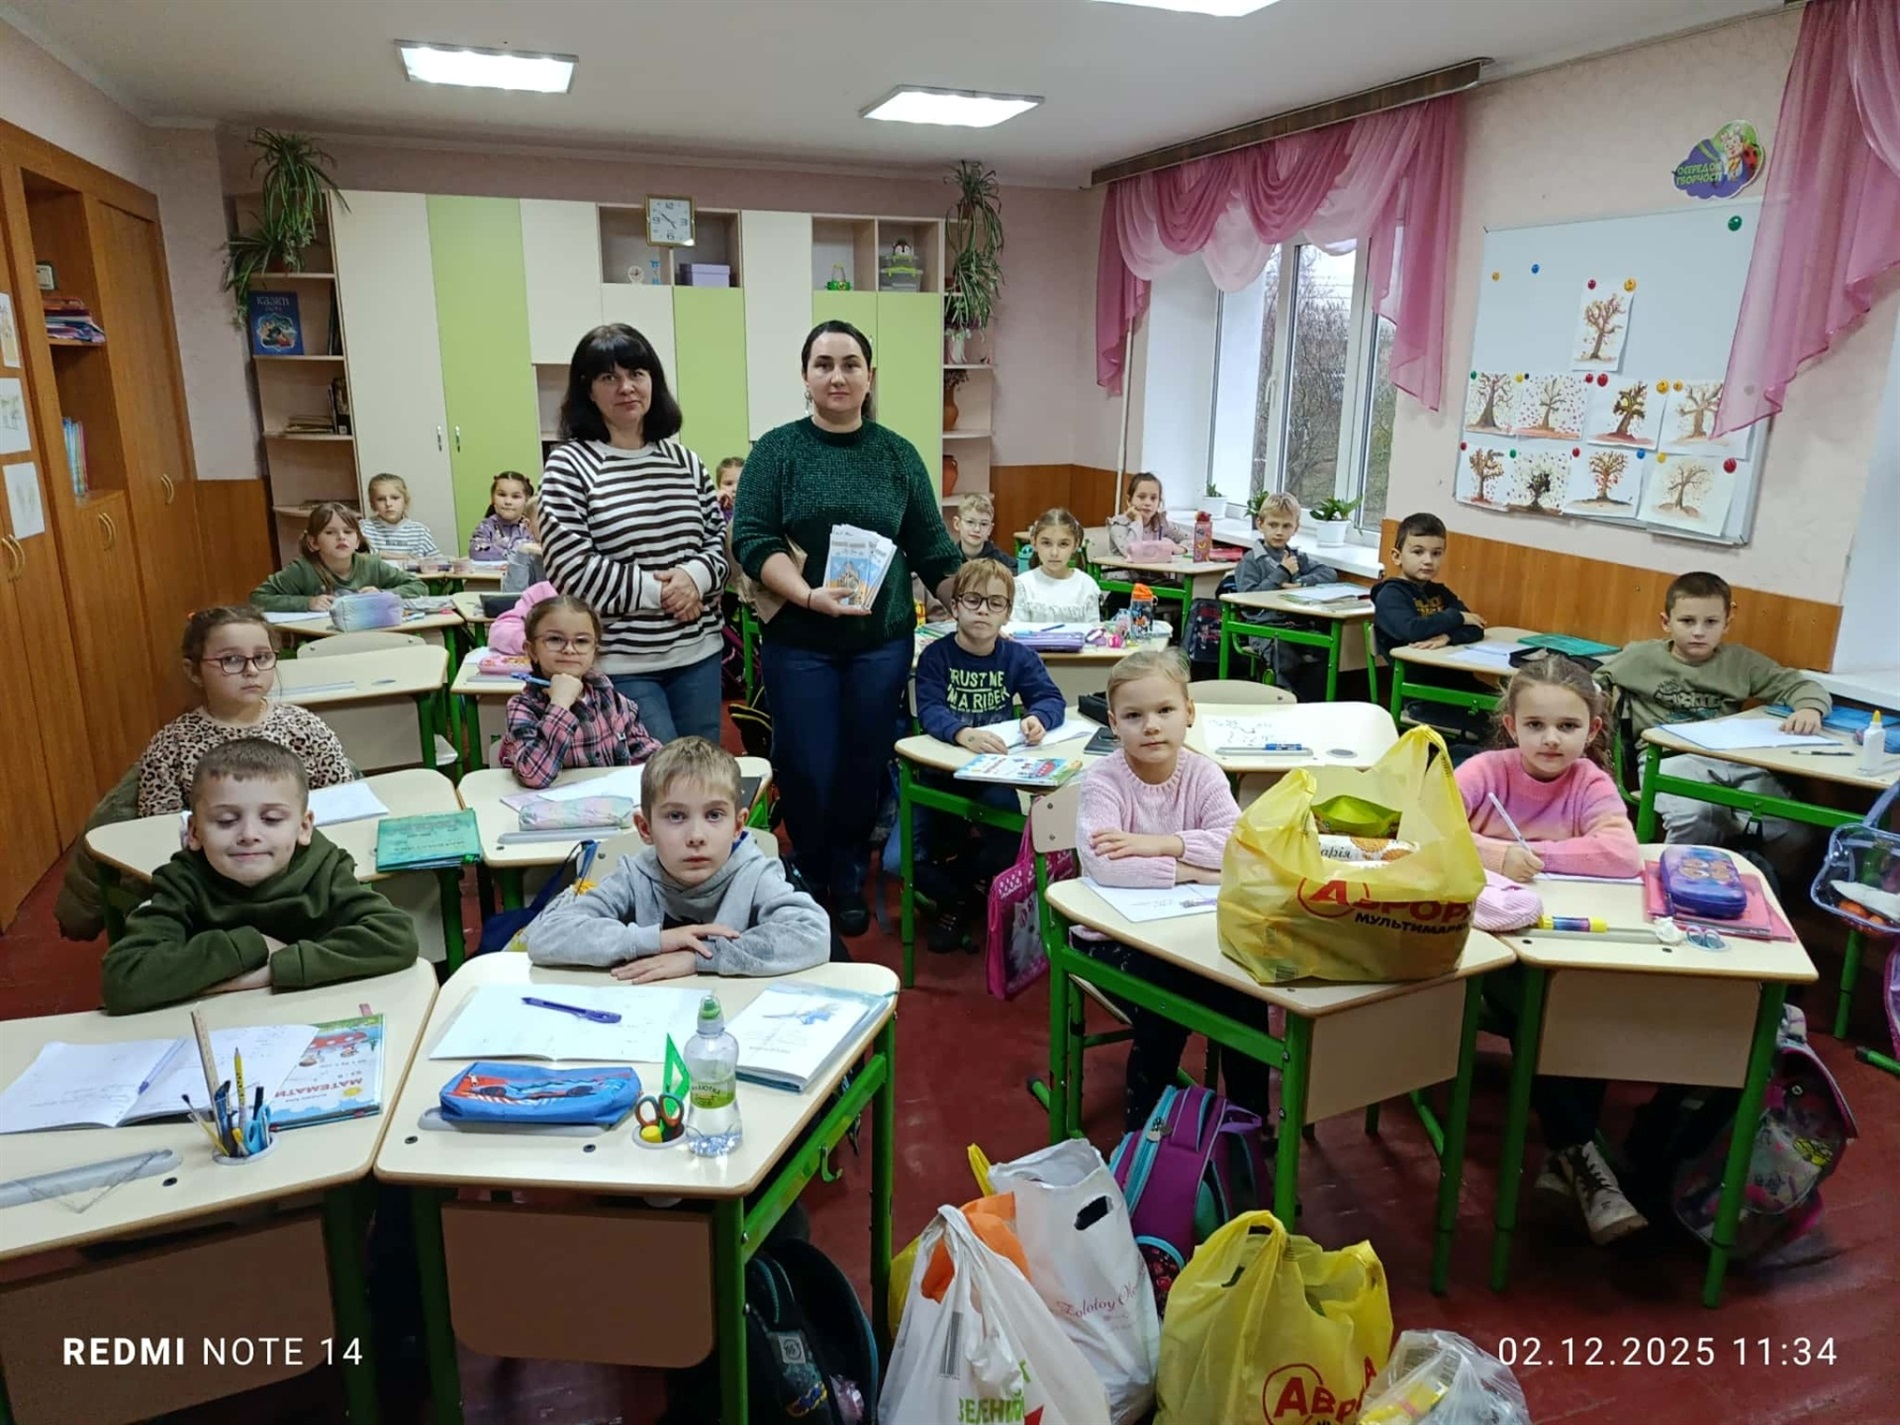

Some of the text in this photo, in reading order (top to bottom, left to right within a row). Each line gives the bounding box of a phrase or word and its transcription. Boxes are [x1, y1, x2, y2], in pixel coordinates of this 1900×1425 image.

[665, 201, 674, 209] 12
[652, 216, 660, 225] 9
[680, 217, 688, 226] 3
[973, 686, 1010, 710] RIDER
[1318, 841, 1351, 859] арія
